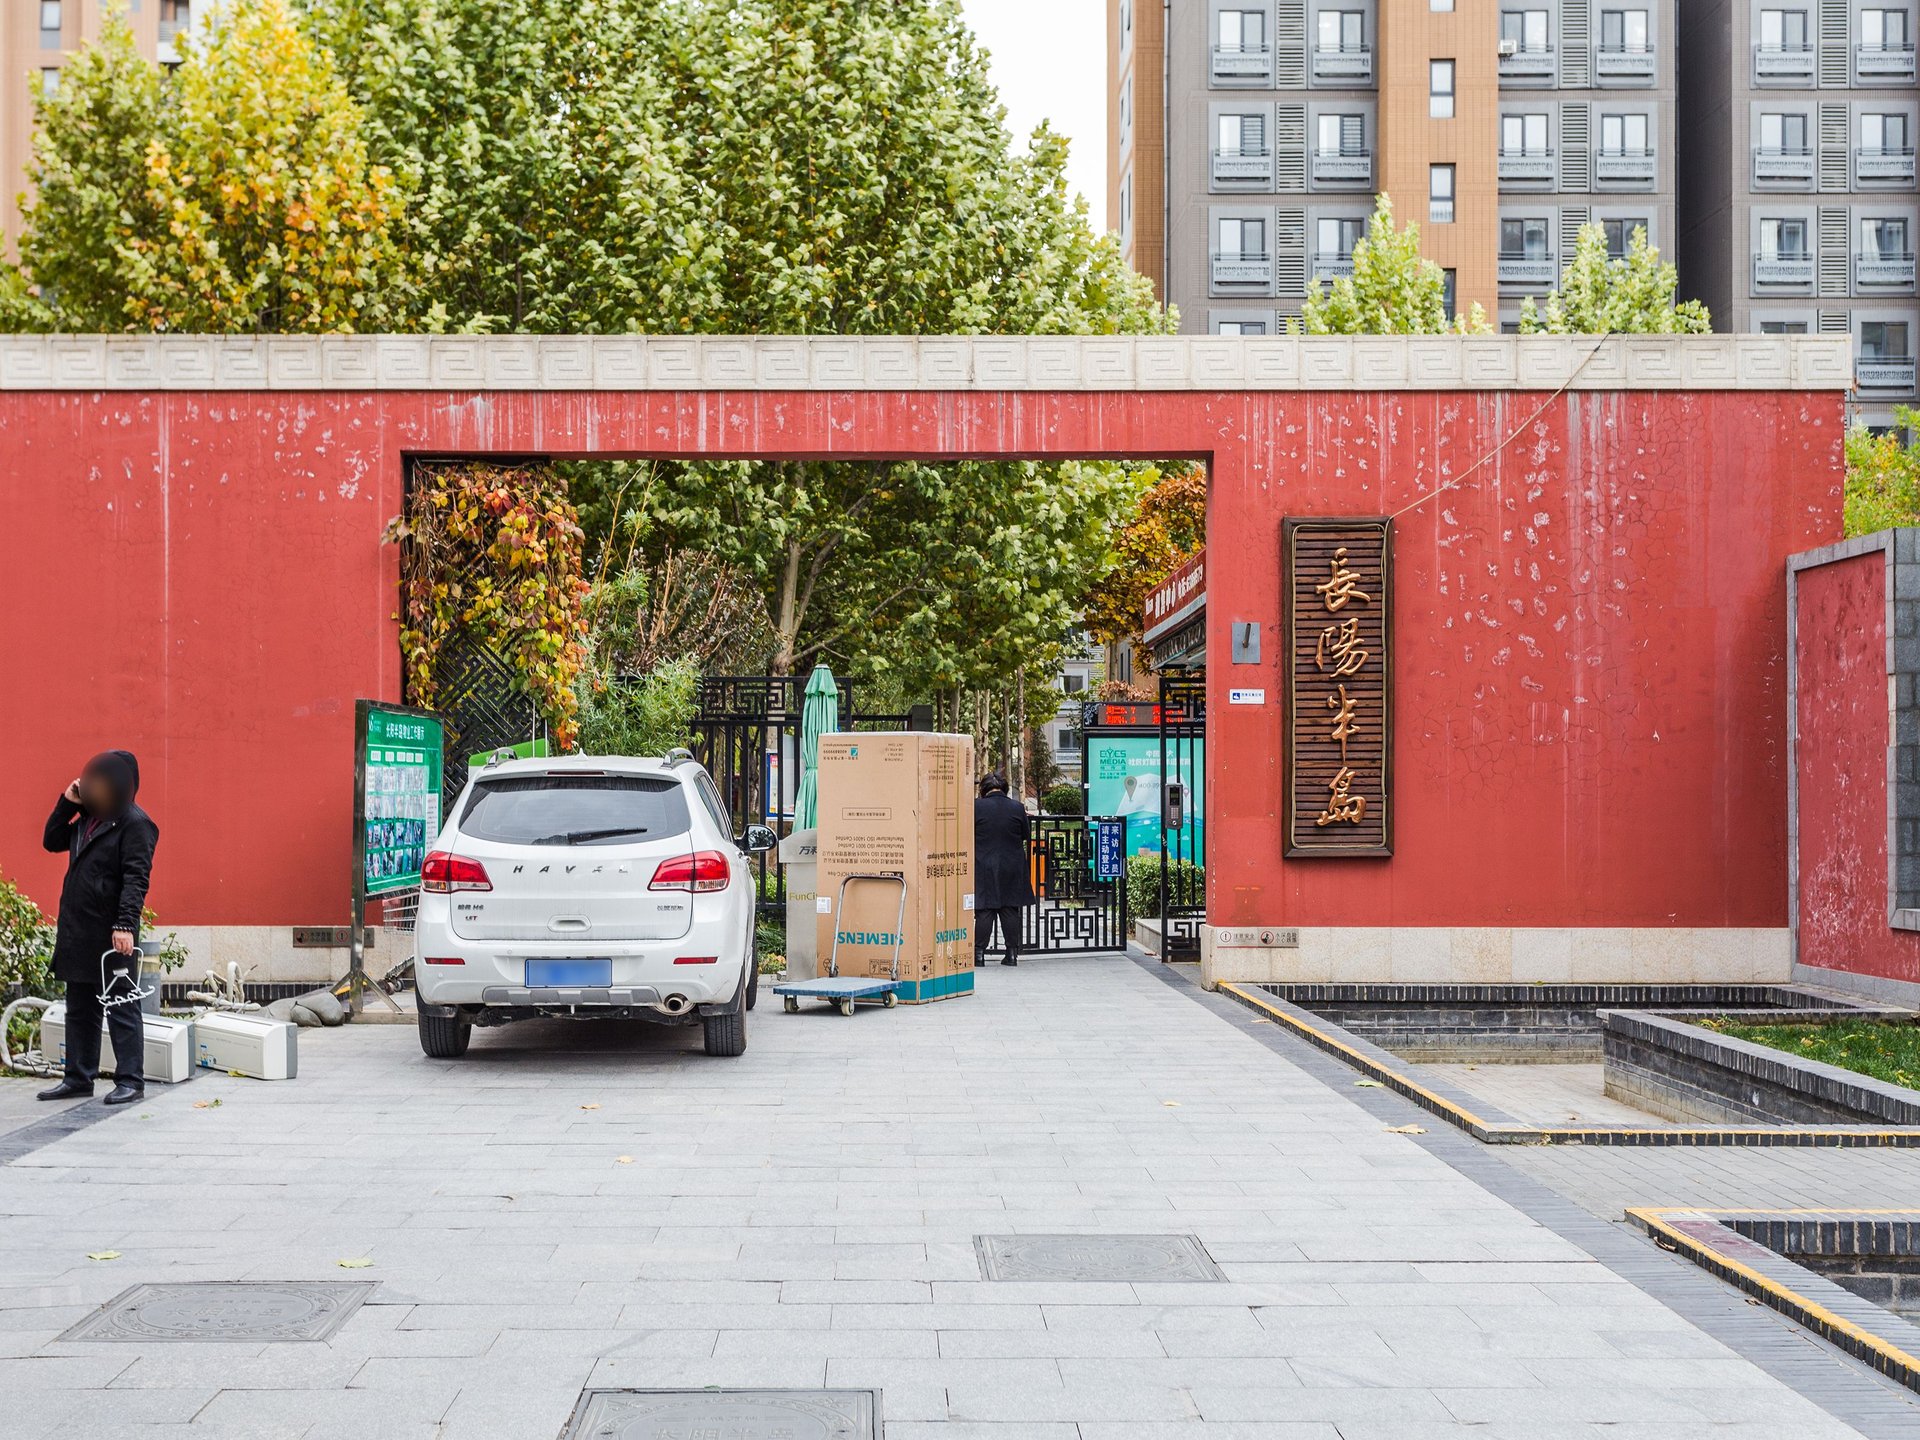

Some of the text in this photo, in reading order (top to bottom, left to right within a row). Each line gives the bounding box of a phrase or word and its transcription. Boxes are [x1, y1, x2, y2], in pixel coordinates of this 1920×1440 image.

[1100, 748, 1126, 758] EYES
[1101, 825, 1110, 873] 请主动登记
[1111, 825, 1119, 873] 来访人员
[789, 891, 817, 901] FunCi
[834, 931, 904, 946] SIEMENS
[935, 928, 967, 943] SIEMENS
